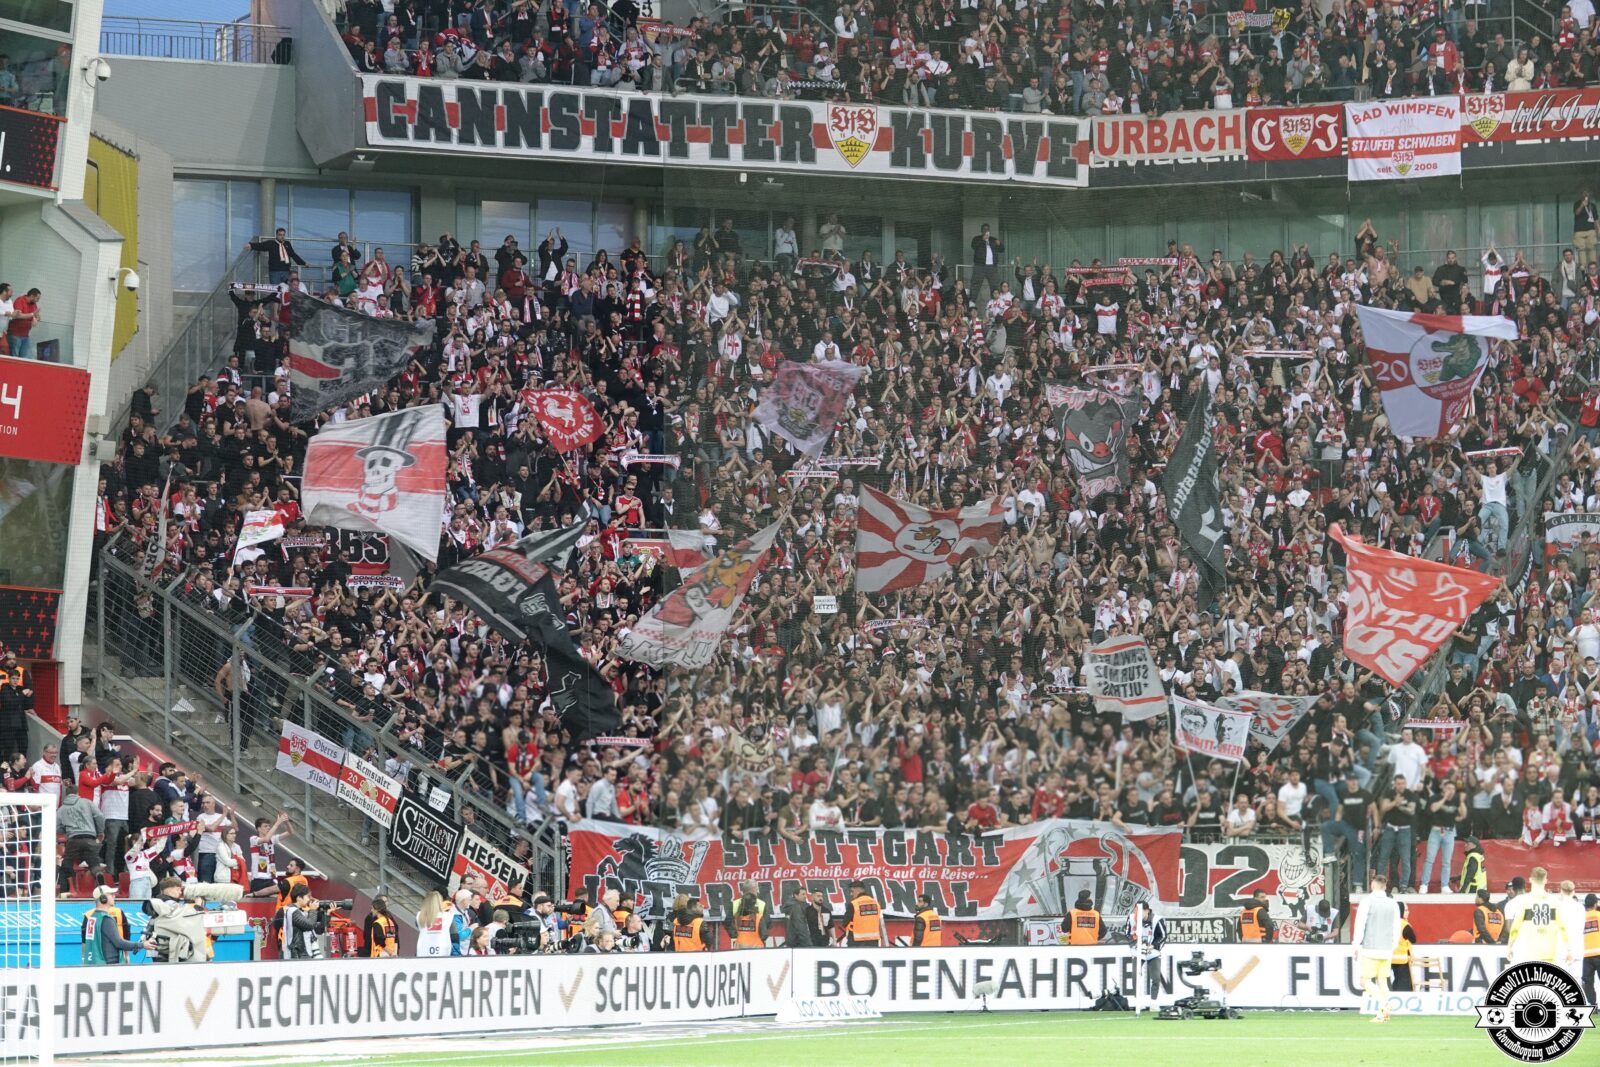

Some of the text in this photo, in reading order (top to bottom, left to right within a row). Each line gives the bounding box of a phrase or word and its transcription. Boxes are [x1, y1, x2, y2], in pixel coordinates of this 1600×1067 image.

[1352, 103, 1456, 125] BAD WIMPFEN
[376, 81, 1079, 180] CANNSTATTER KURVE
[1097, 115, 1241, 156] URBACH
[1351, 134, 1457, 152] STAUFER SCHWABEN
[1414, 163, 1438, 171] 2008
[1373, 359, 1408, 382] 20
[347, 772, 358, 784] 20
[381, 794, 391, 805] 17
[722, 829, 1005, 868] STUTTGART
[462, 837, 525, 887] HESSEN
[715, 869, 747, 881] Nach
[750, 868, 769, 880] all
[773, 867, 797, 879] der
[800, 865, 850, 878] Scheiße
[853, 866, 890, 880] geht's
[893, 866, 914, 879] auf
[918, 867, 937, 879] die
[1532, 904, 1550, 926] 33
[237, 969, 541, 1029] RECHNUNGSFAHRTEN
[594, 962, 751, 1013] SCHULTOUREN
